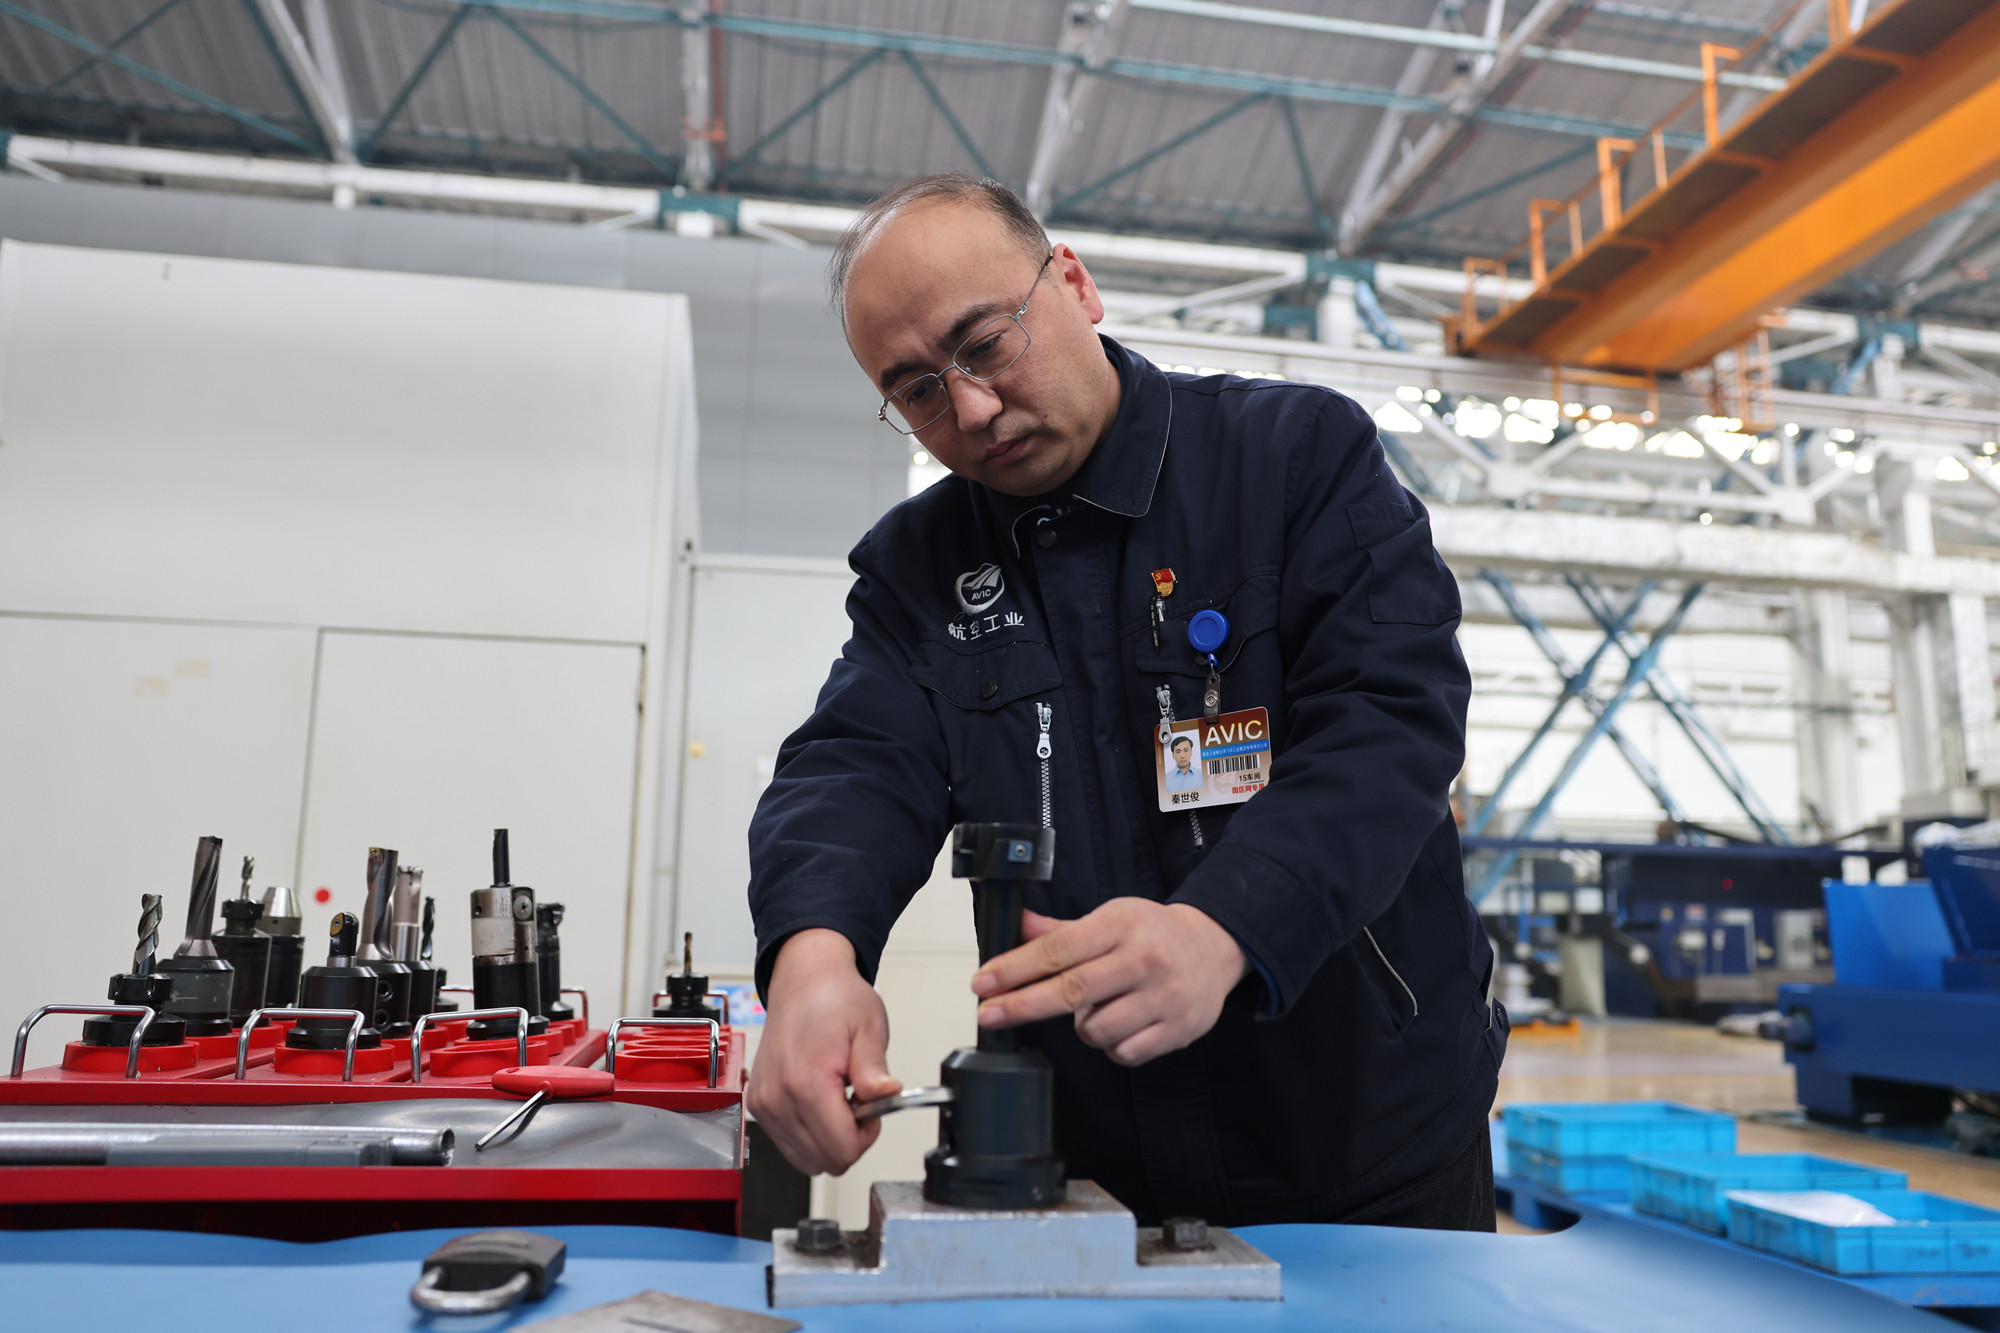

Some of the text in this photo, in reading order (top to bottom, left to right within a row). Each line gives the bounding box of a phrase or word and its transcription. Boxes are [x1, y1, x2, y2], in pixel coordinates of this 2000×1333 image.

[971, 589, 992, 601] AVIC
[947, 611, 1025, 641] 航空工业
[1205, 719, 1263, 747] AVIC
[1238, 772, 1261, 782] 15车间
[1171, 791, 1200, 805] 秦世俊
